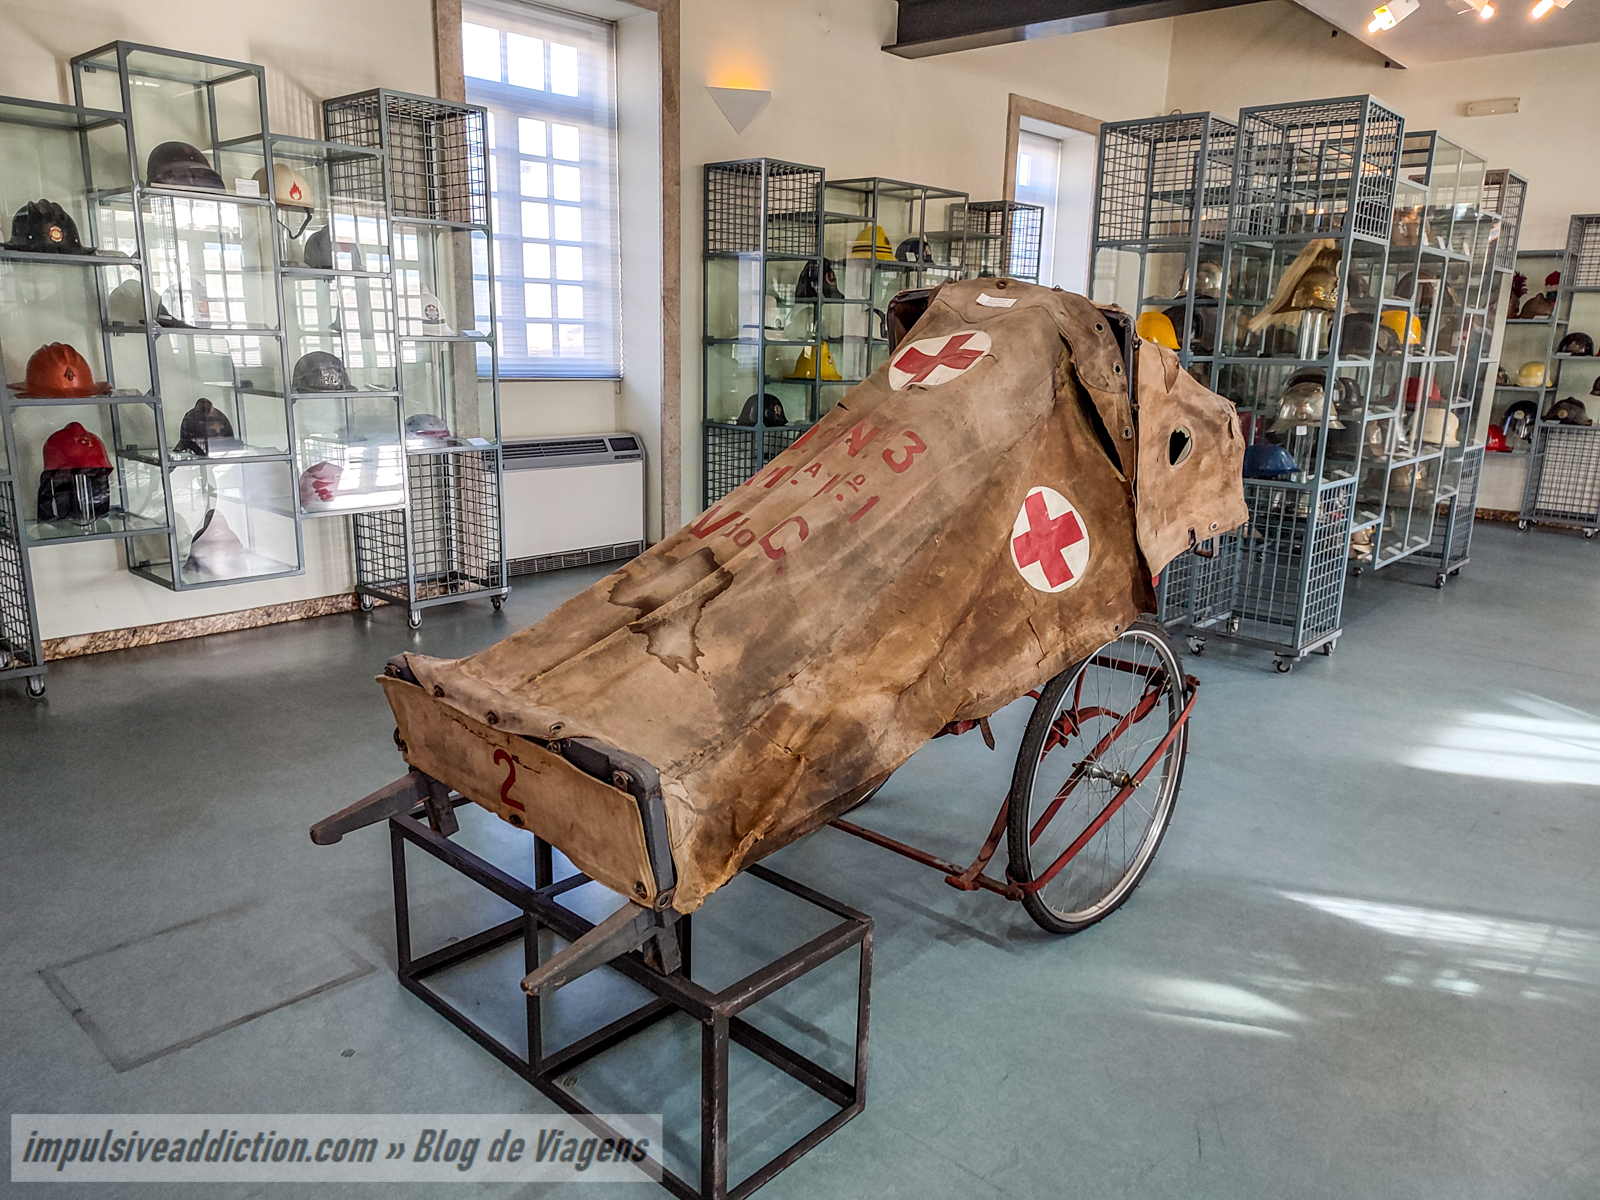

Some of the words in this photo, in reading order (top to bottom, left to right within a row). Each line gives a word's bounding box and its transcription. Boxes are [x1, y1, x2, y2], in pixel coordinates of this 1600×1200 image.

[882, 430, 928, 474] 3
[848, 495, 881, 525] 1
[493, 748, 526, 812] 2
